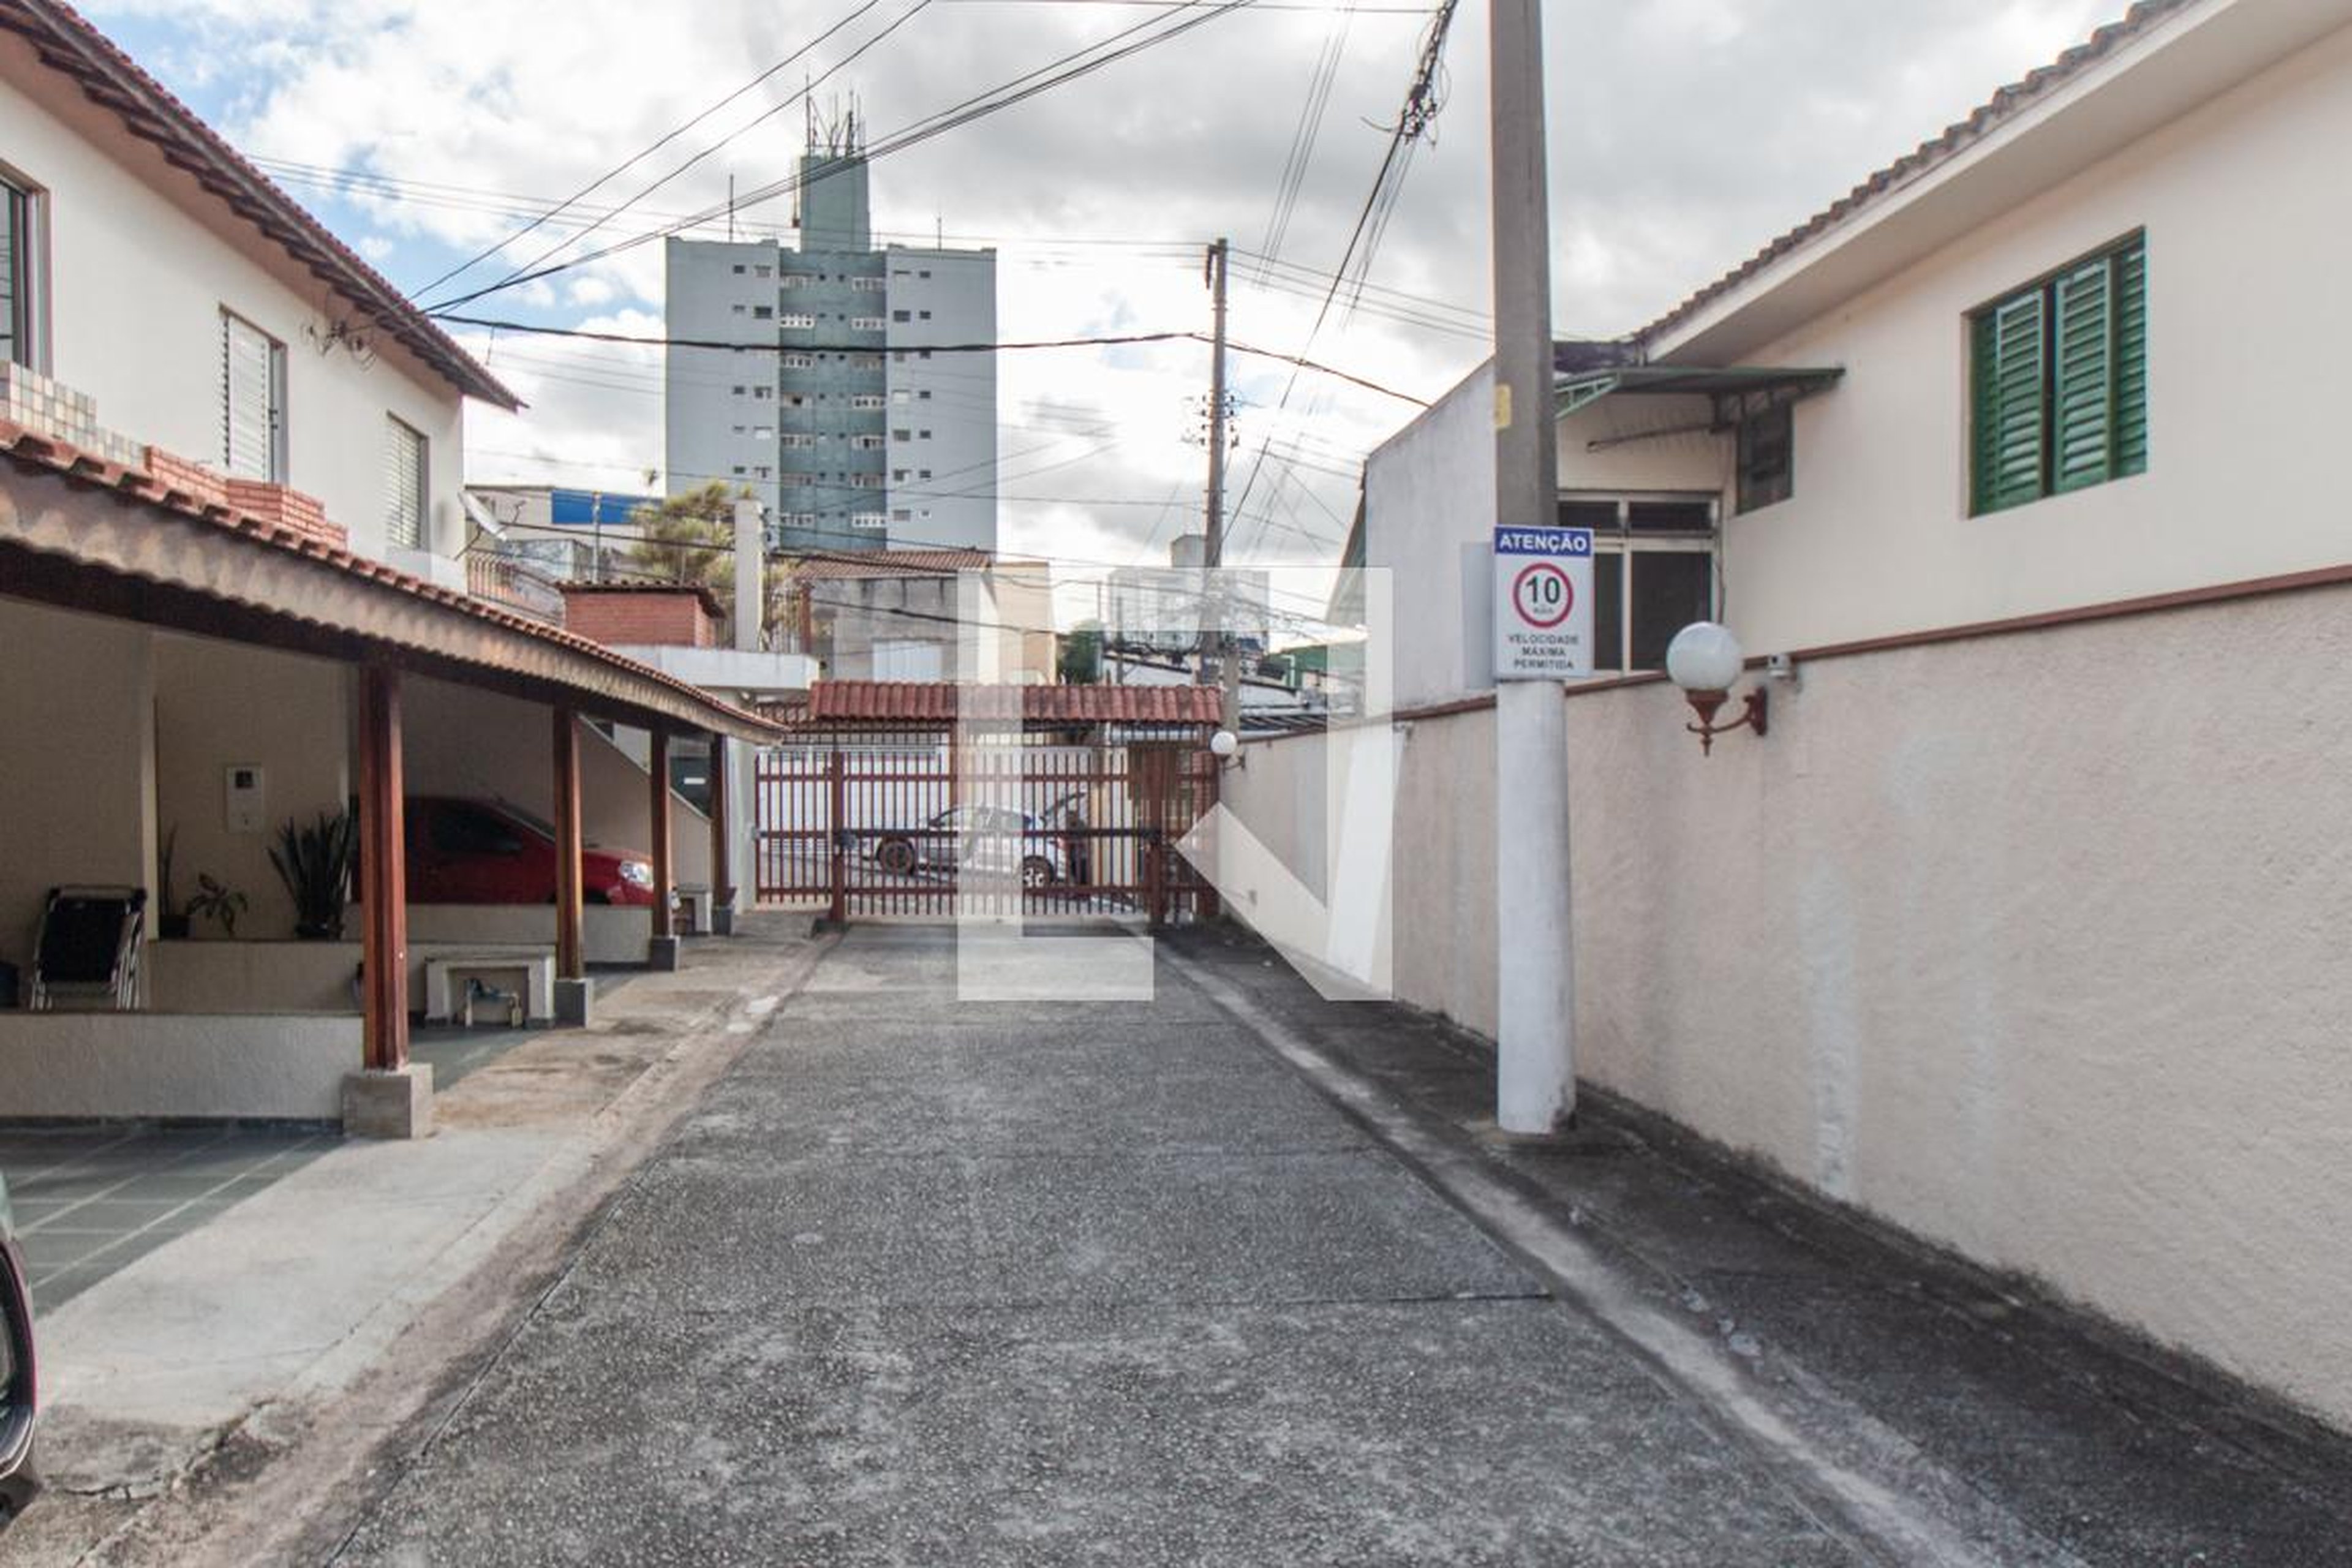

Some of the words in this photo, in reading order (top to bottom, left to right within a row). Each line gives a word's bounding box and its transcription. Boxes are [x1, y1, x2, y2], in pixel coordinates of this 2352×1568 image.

[1499, 532, 1587, 552] ATENÇÃO
[1525, 576, 1561, 605] 10
[1507, 634, 1579, 644] VELOCIDADE
[1513, 659, 1574, 669] PERMITIDA
